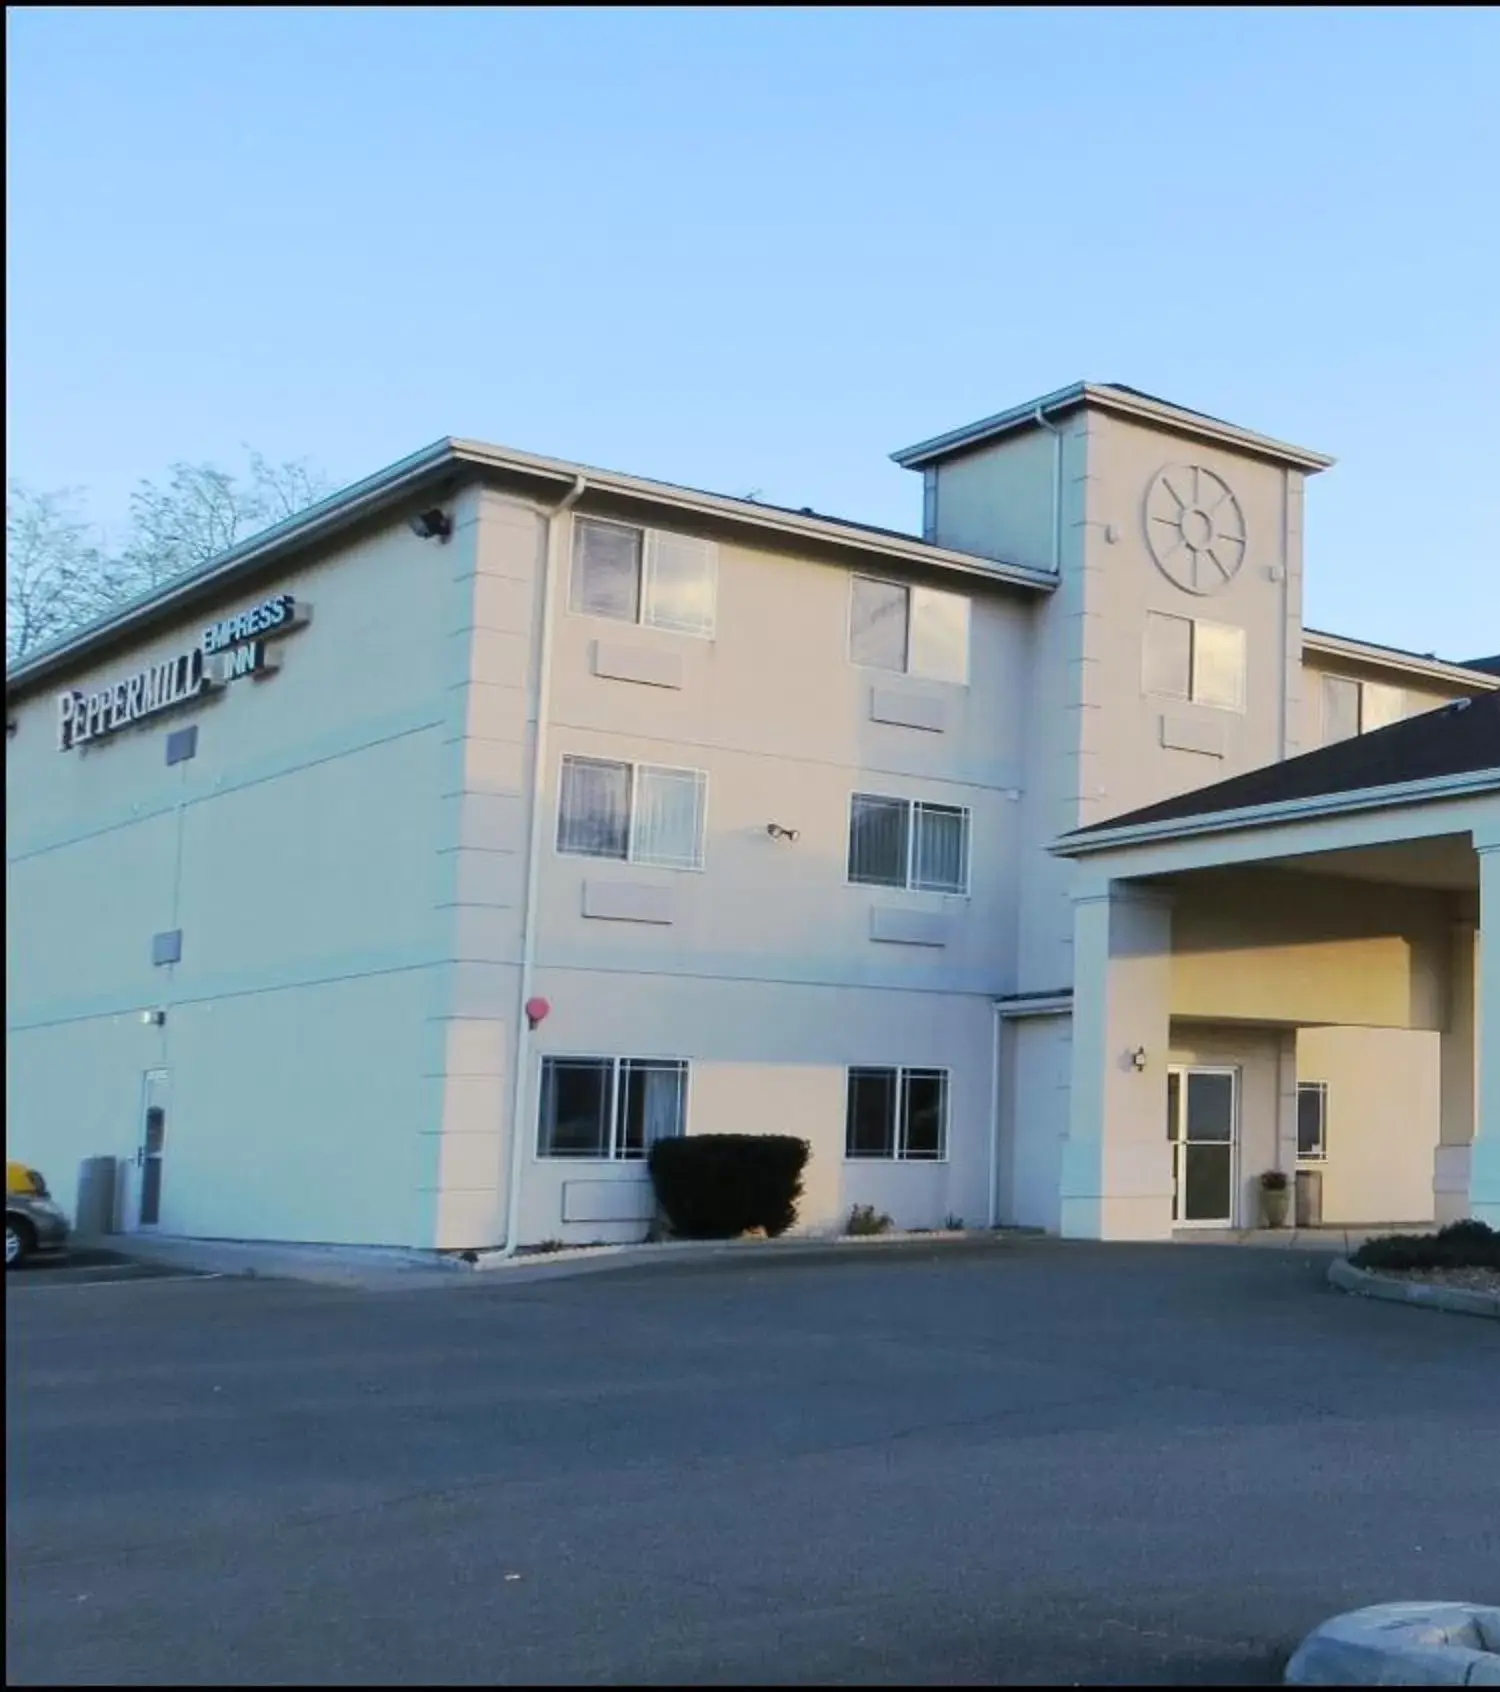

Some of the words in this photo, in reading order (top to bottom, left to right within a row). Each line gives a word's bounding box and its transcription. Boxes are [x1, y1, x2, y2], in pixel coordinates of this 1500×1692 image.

[203, 595, 291, 651] EMPRESS
[224, 641, 259, 682] INN
[59, 650, 202, 752] PEPPERMILL
